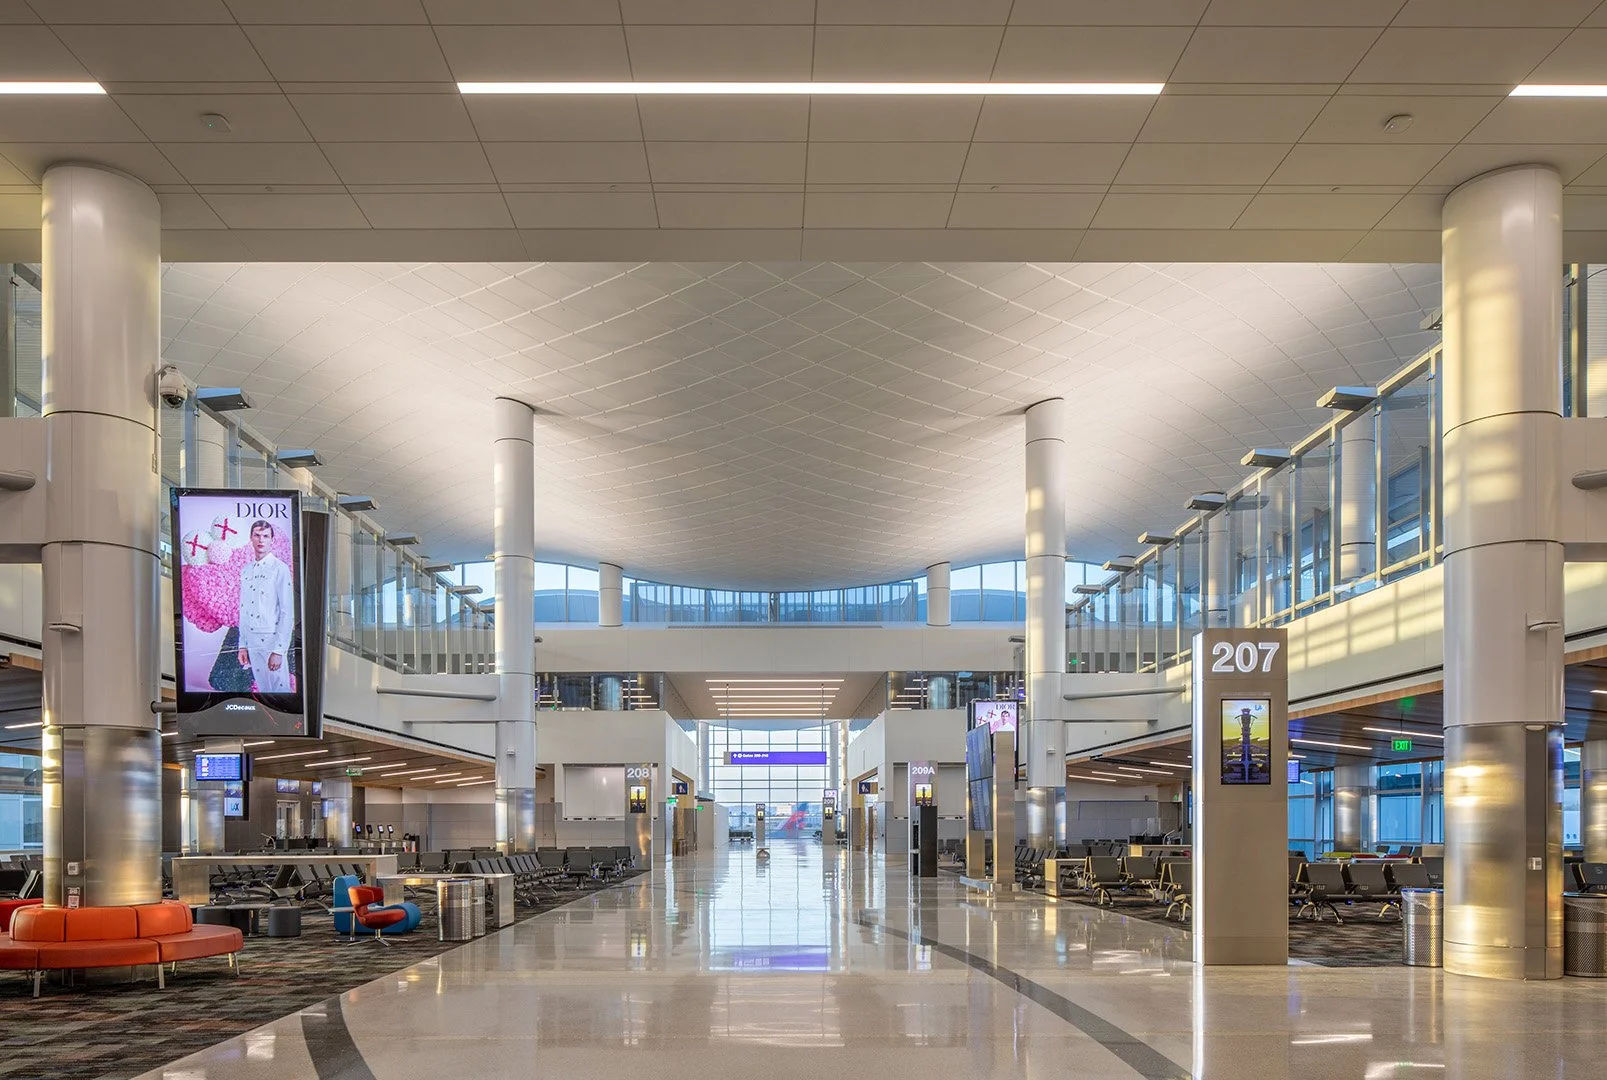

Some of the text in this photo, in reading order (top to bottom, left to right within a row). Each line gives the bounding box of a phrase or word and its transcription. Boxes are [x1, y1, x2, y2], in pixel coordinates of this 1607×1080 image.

[236, 502, 288, 519] DIOR
[1211, 641, 1280, 673] 207
[1395, 740, 1409, 751] EXIT
[627, 767, 649, 778] 208
[912, 766, 935, 774] 209A
